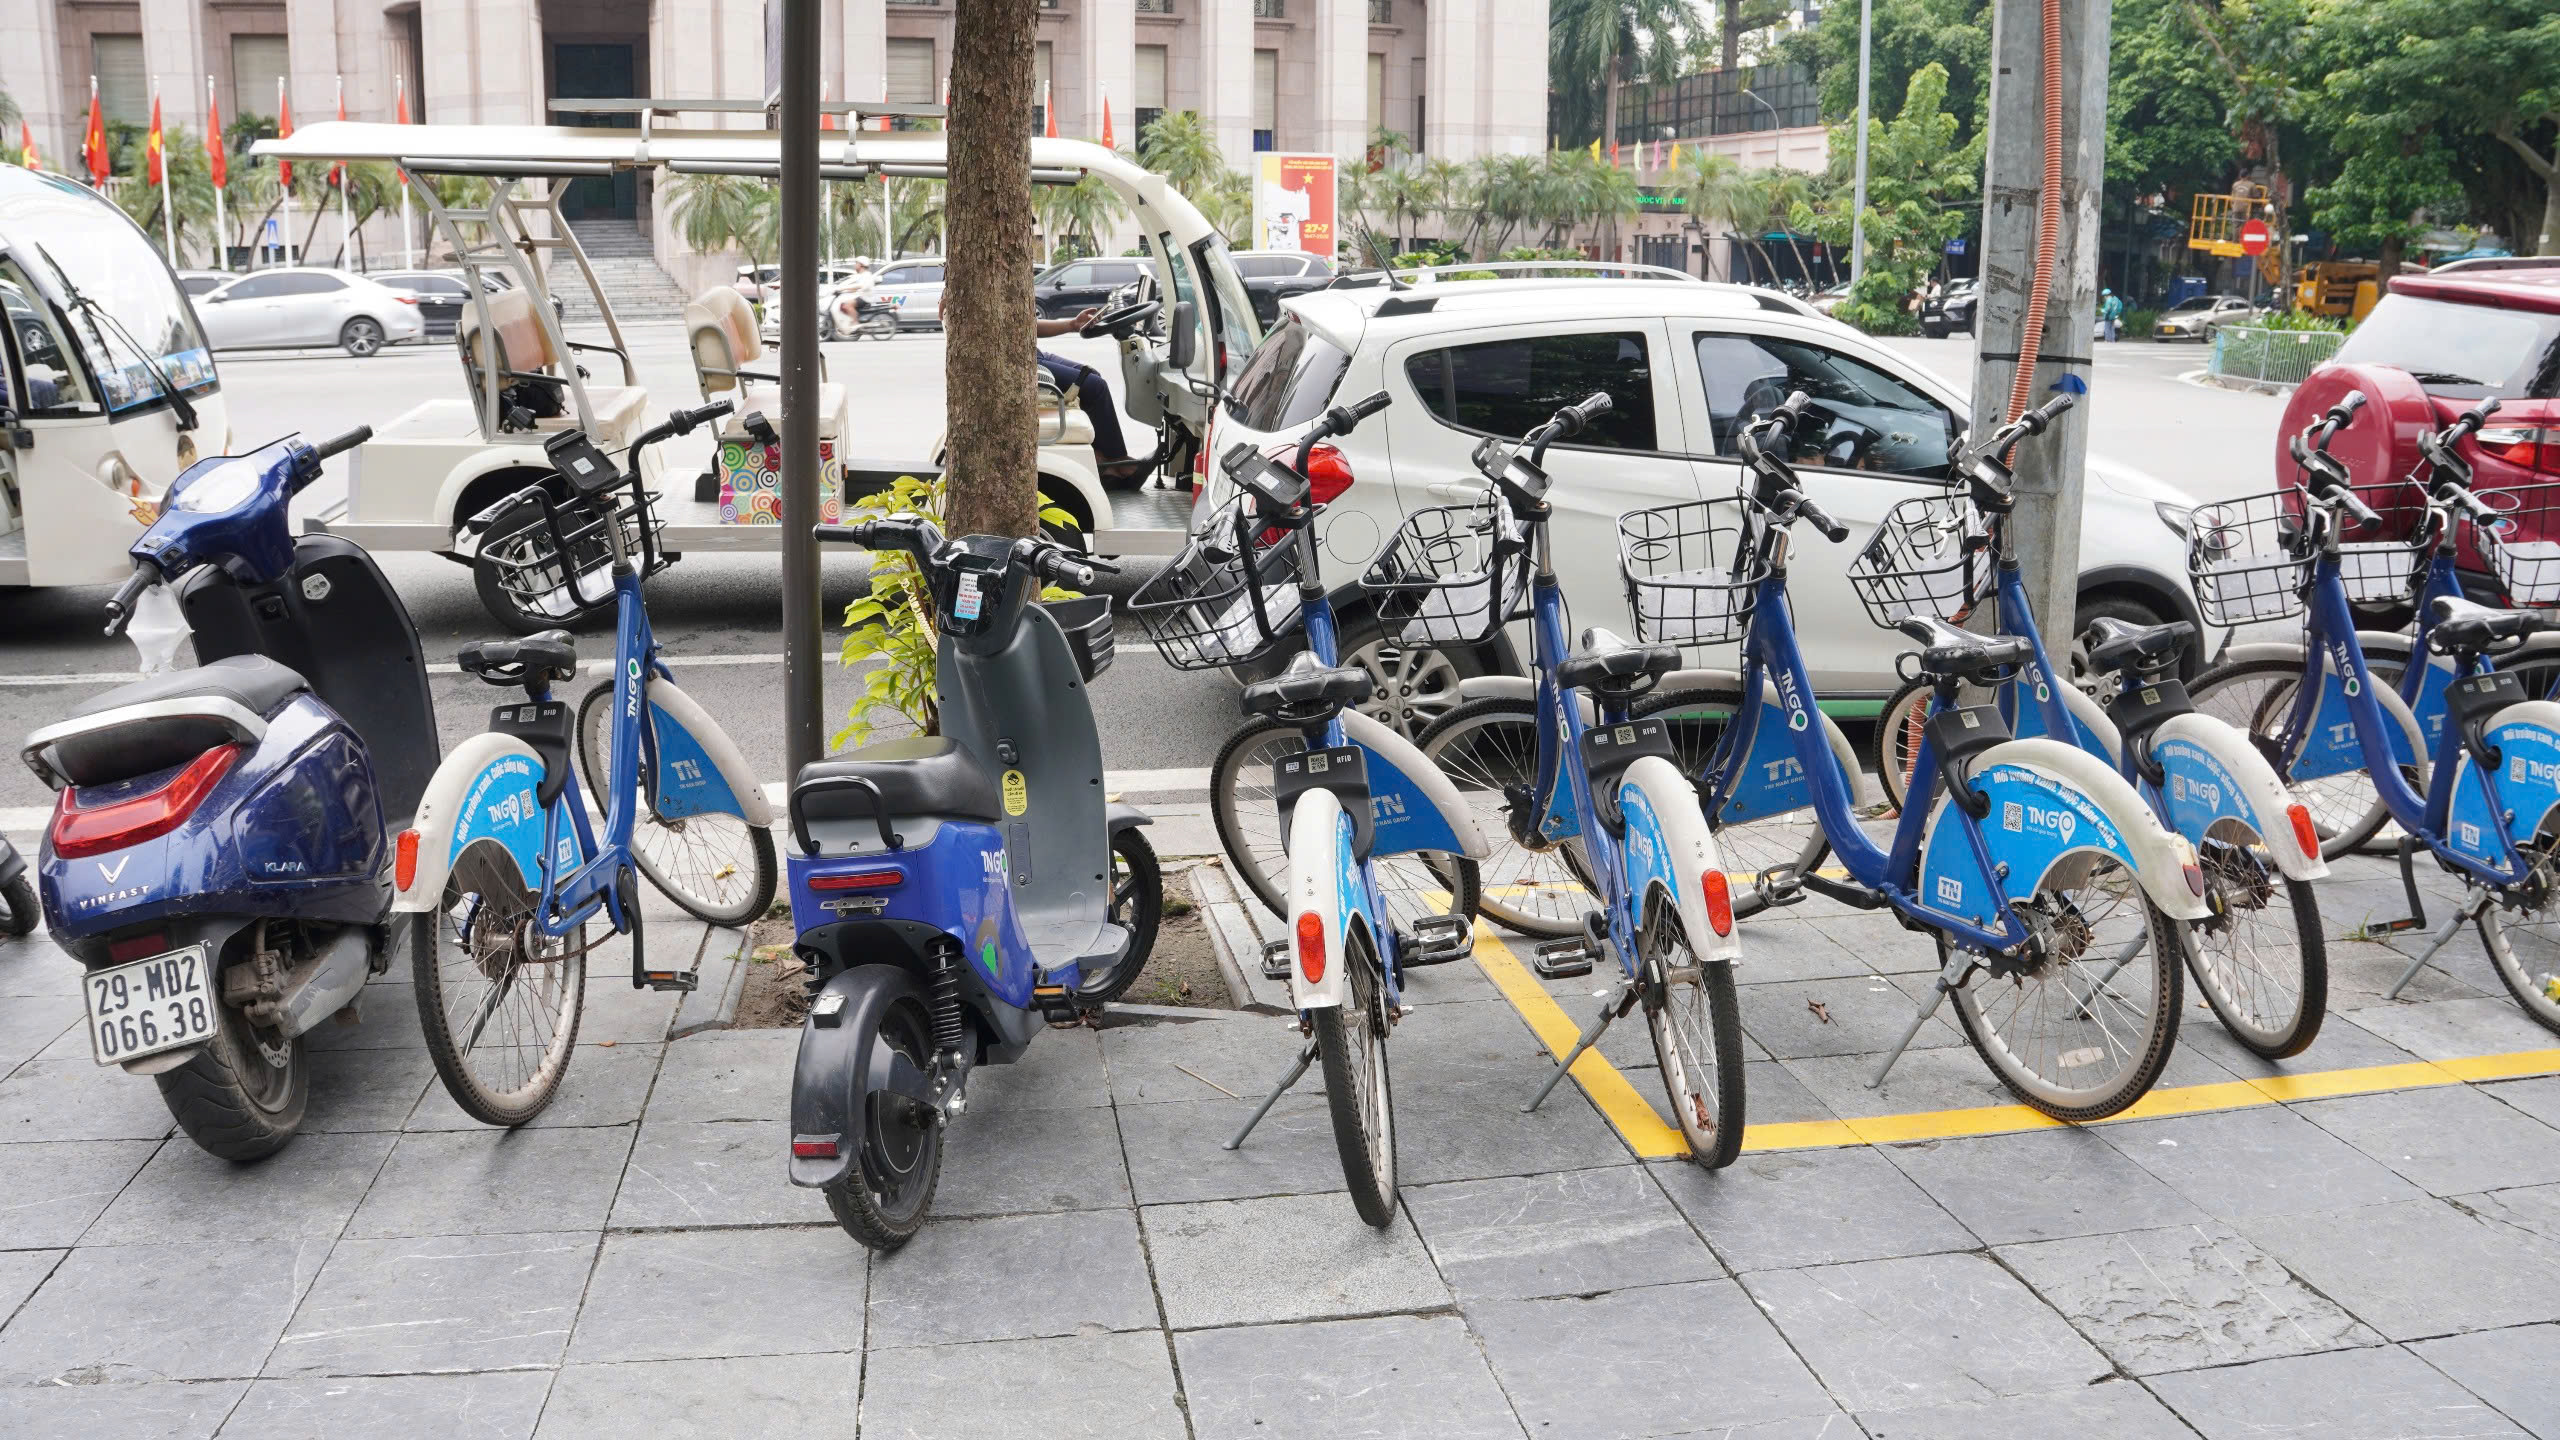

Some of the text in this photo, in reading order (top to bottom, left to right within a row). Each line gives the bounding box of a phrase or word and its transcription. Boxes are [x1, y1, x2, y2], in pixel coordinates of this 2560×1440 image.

[1304, 223, 1329, 233] 27-7
[1642, 727, 1657, 735] RFID
[2427, 714, 2446, 731] T
[1336, 754, 1351, 764] RFID
[671, 759, 701, 780] TN
[1791, 775, 1805, 784] GRO
[2027, 806, 2076, 845] TNGO
[265, 861, 305, 872] KLARA
[79, 885, 150, 910] VINFAST
[94, 955, 200, 1017] 29-MĐ2
[100, 996, 208, 1057] 066.38
